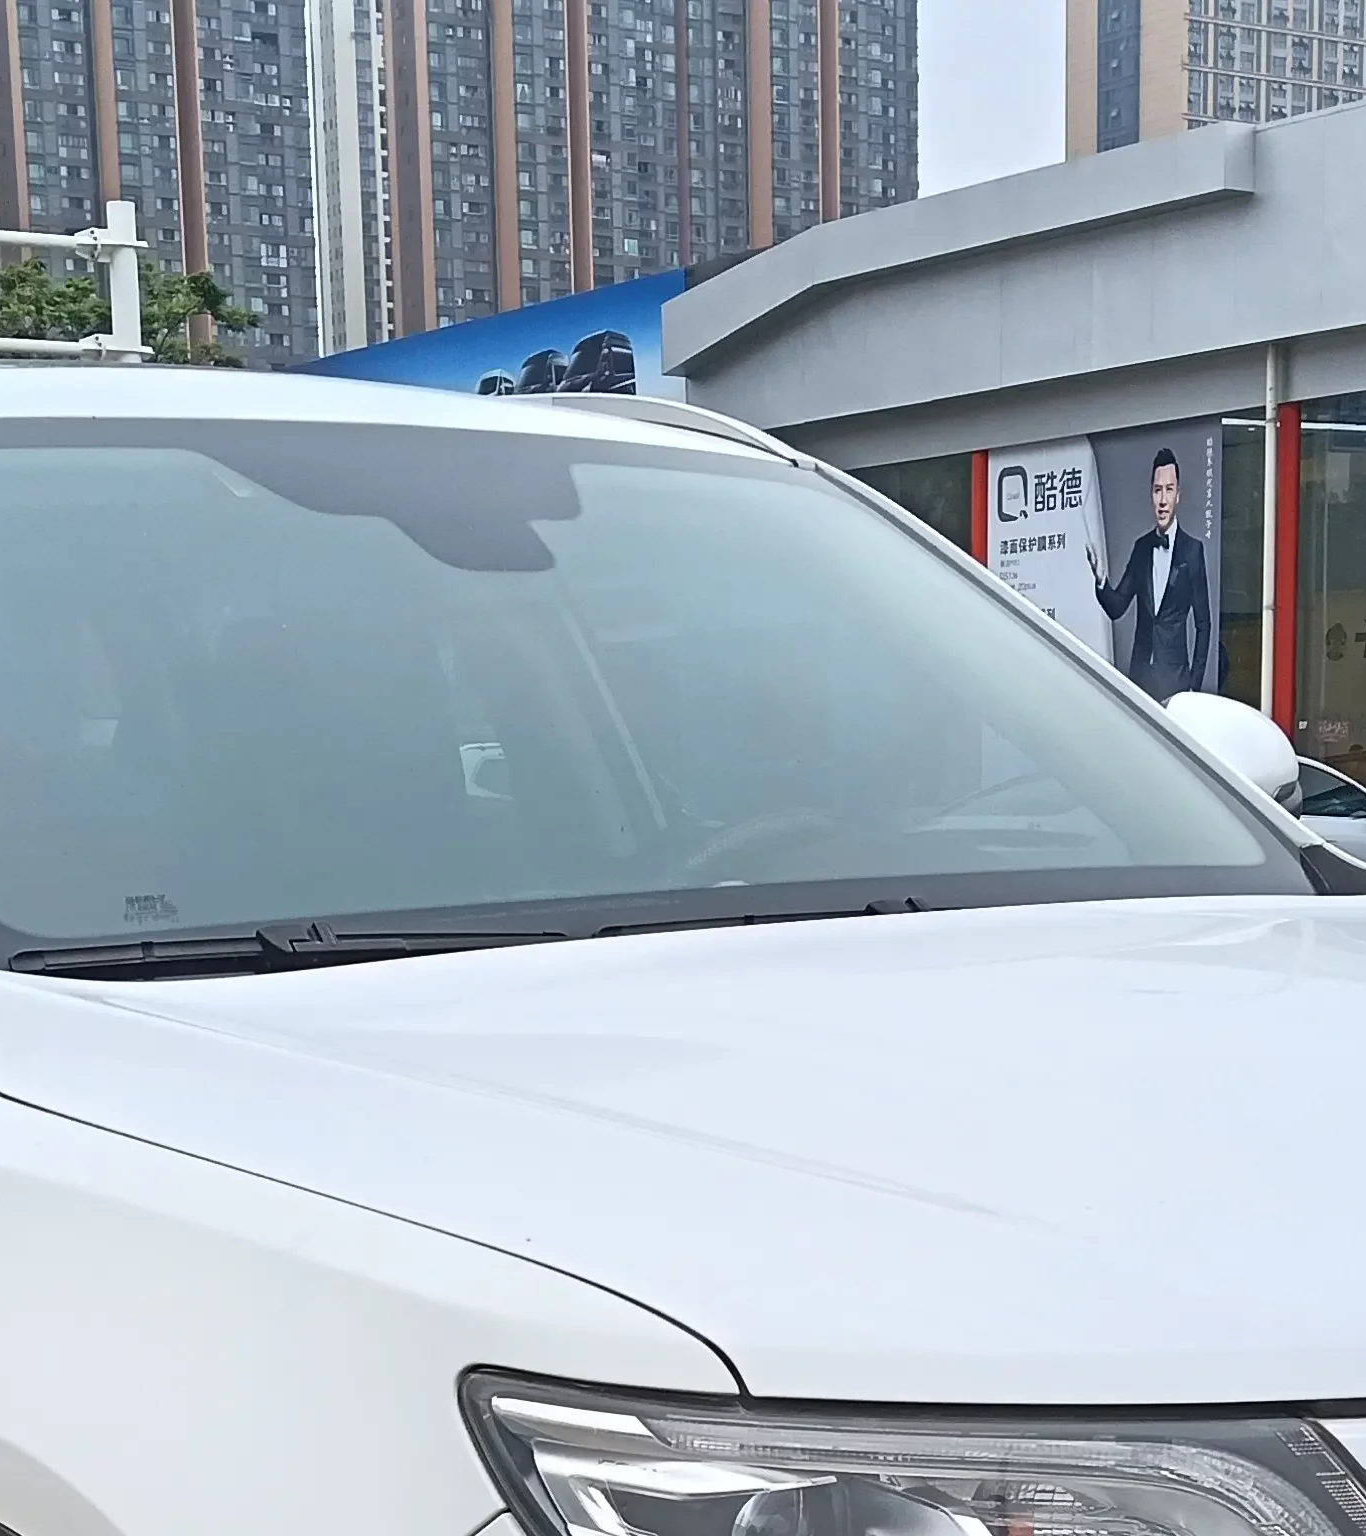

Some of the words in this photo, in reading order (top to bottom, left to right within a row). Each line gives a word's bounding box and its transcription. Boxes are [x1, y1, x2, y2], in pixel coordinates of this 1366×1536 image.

[1034, 467, 1083, 513] 酷德
[1000, 533, 1066, 556] 漆面保护膜系列
